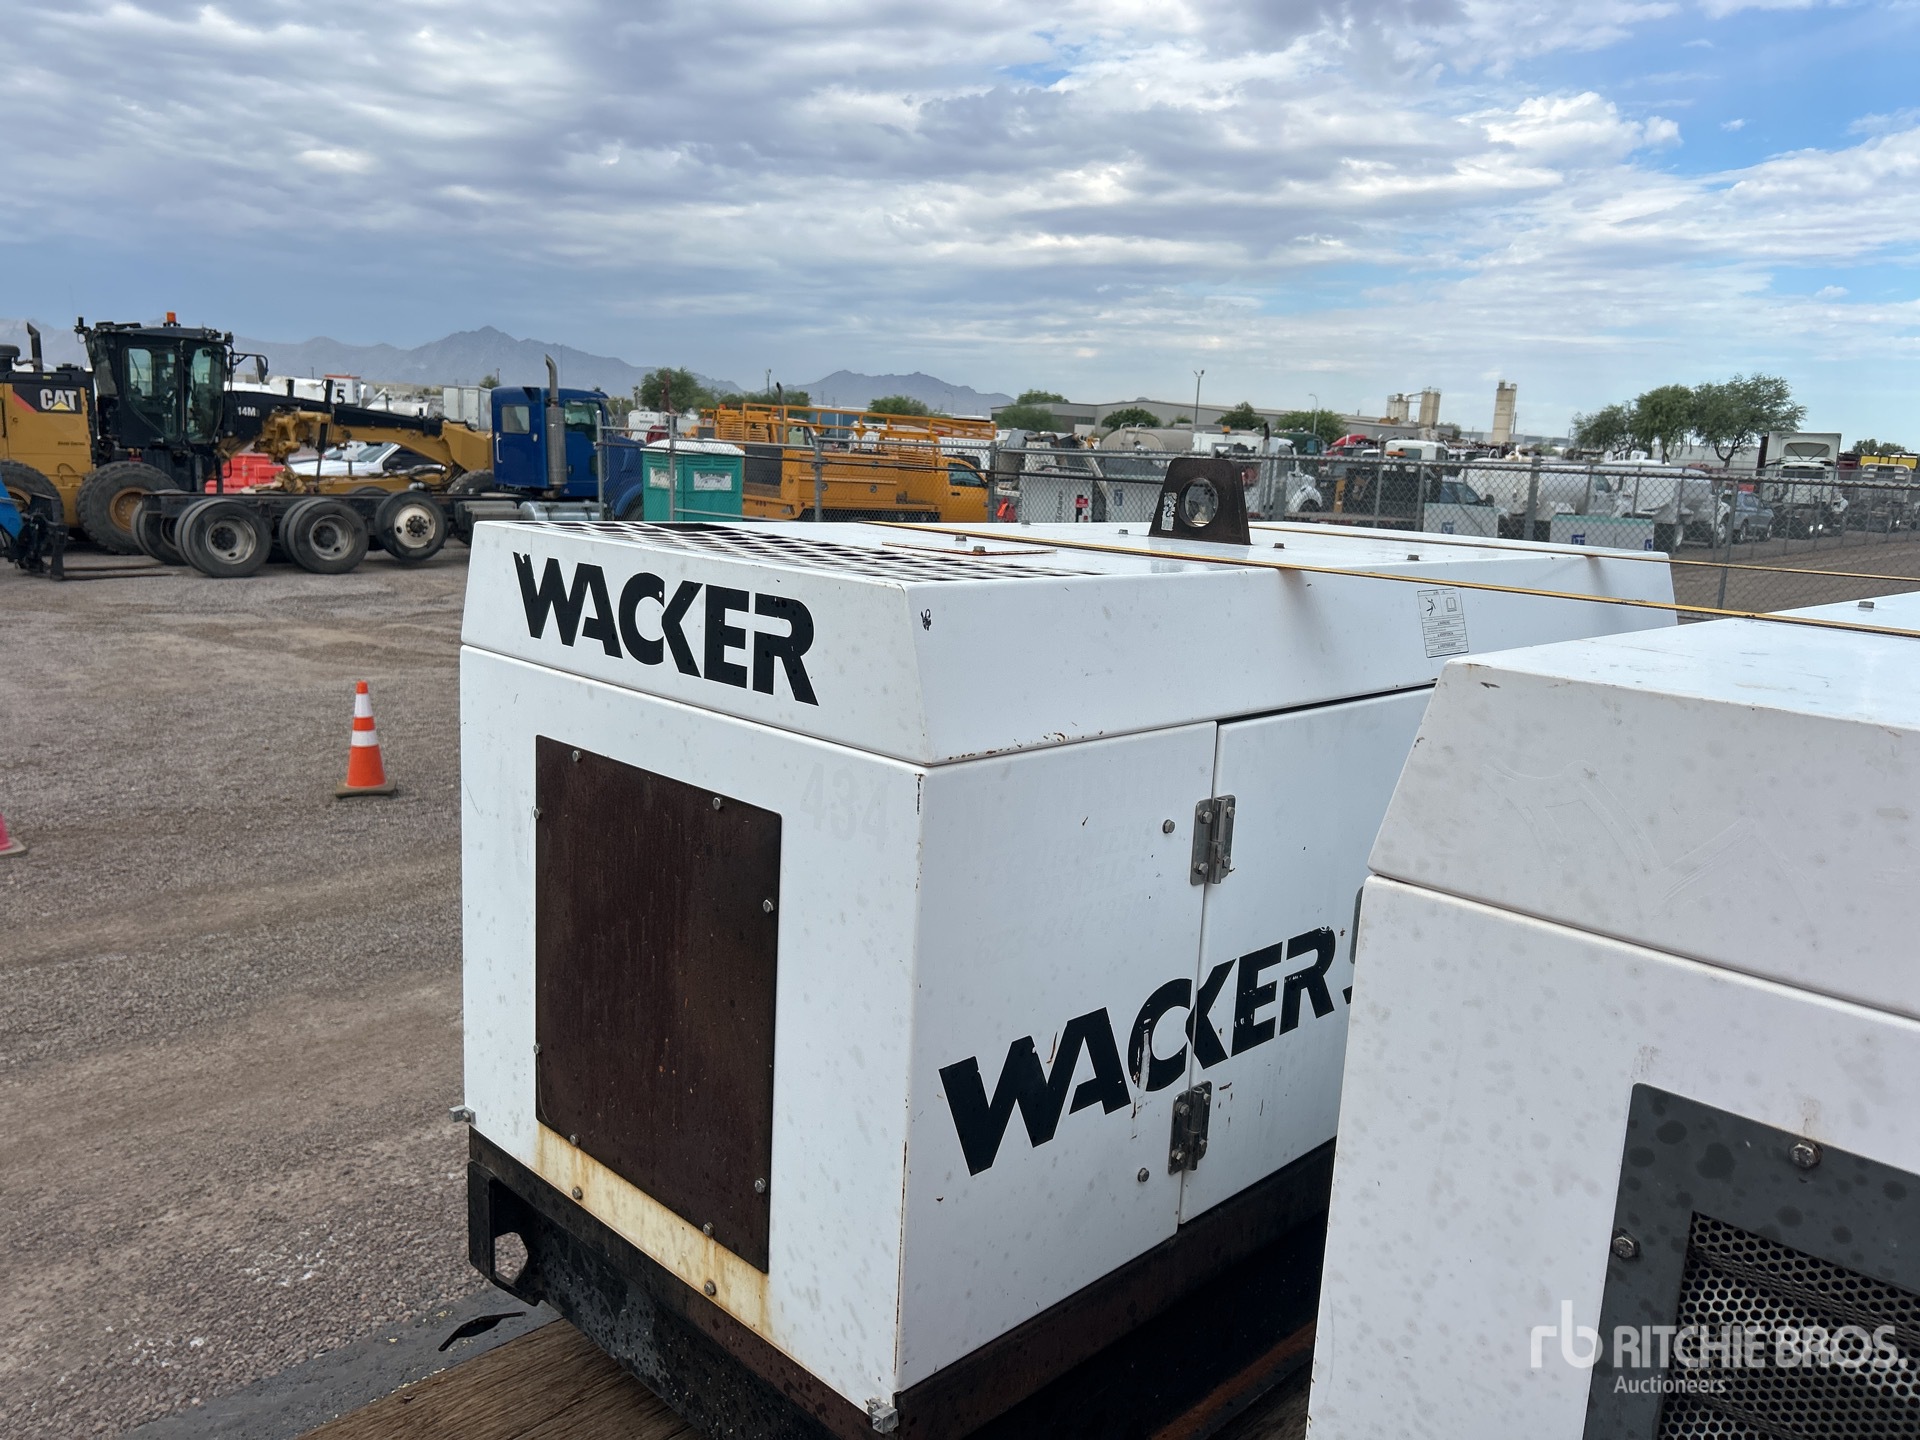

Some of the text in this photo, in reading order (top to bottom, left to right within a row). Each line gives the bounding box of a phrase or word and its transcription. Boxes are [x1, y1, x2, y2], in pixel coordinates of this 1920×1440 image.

[40, 388, 77, 411] CAT
[336, 389, 346, 404] 5
[237, 406, 256, 417] 14M
[513, 551, 819, 706] WACKER
[938, 926, 1336, 1177] WACKER
